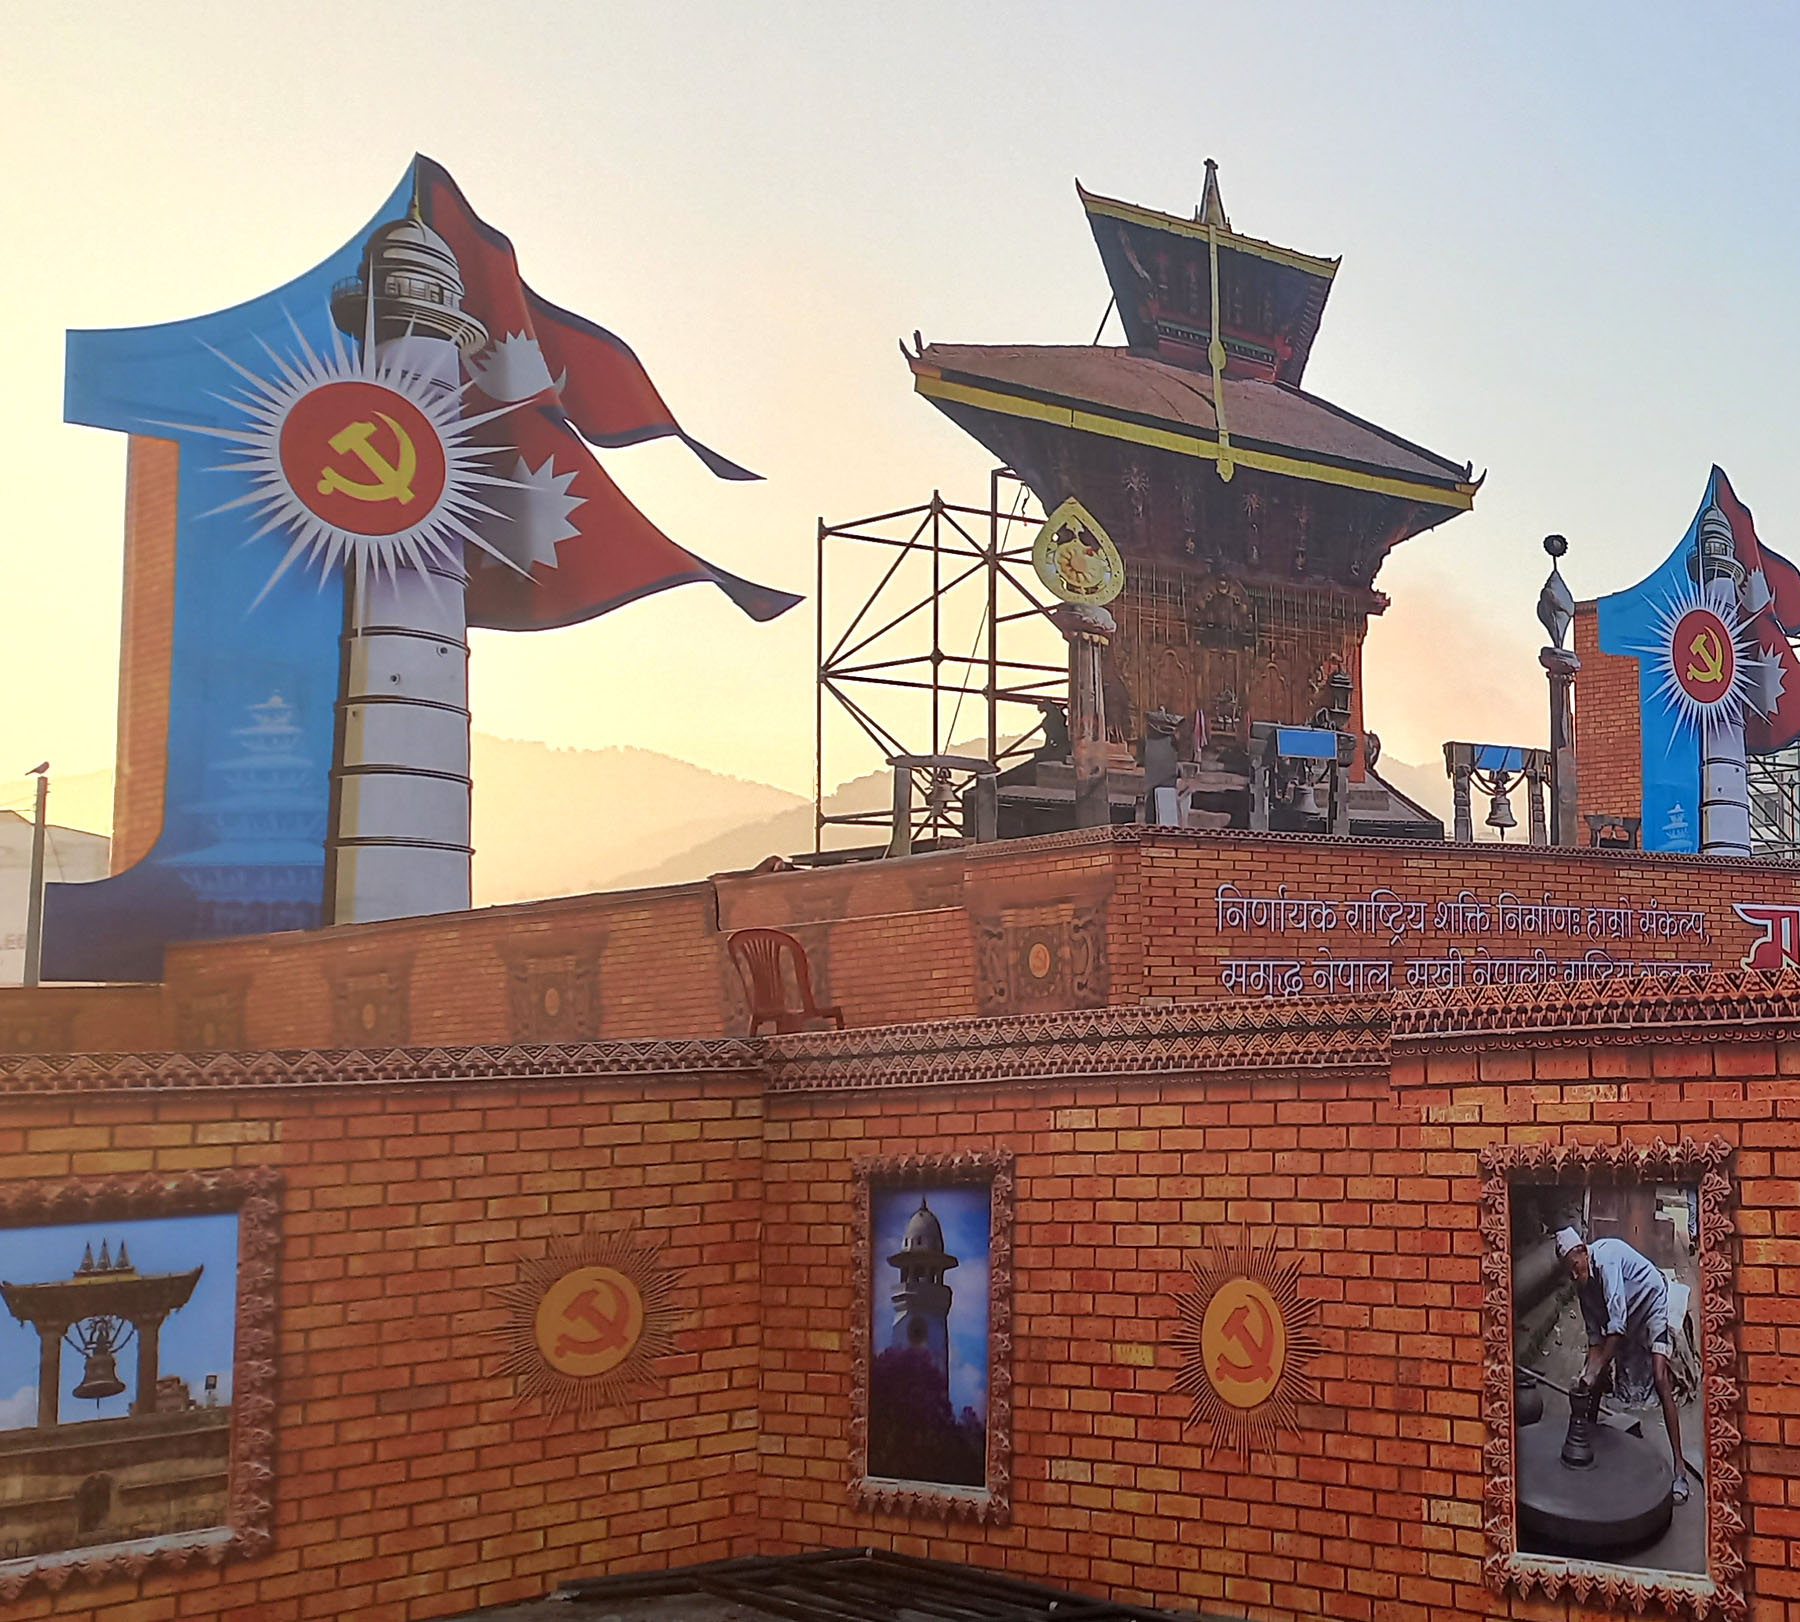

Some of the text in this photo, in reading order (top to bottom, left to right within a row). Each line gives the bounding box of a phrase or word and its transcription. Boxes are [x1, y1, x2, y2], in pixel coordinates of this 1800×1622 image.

[1214, 883, 1340, 933] निर्णायक
[1343, 888, 1428, 946] राष्ट्रिय
[1433, 890, 1492, 936] शक्ति
[1585, 896, 1634, 943] हाम्रो
[1404, 946, 1467, 991] सखी
